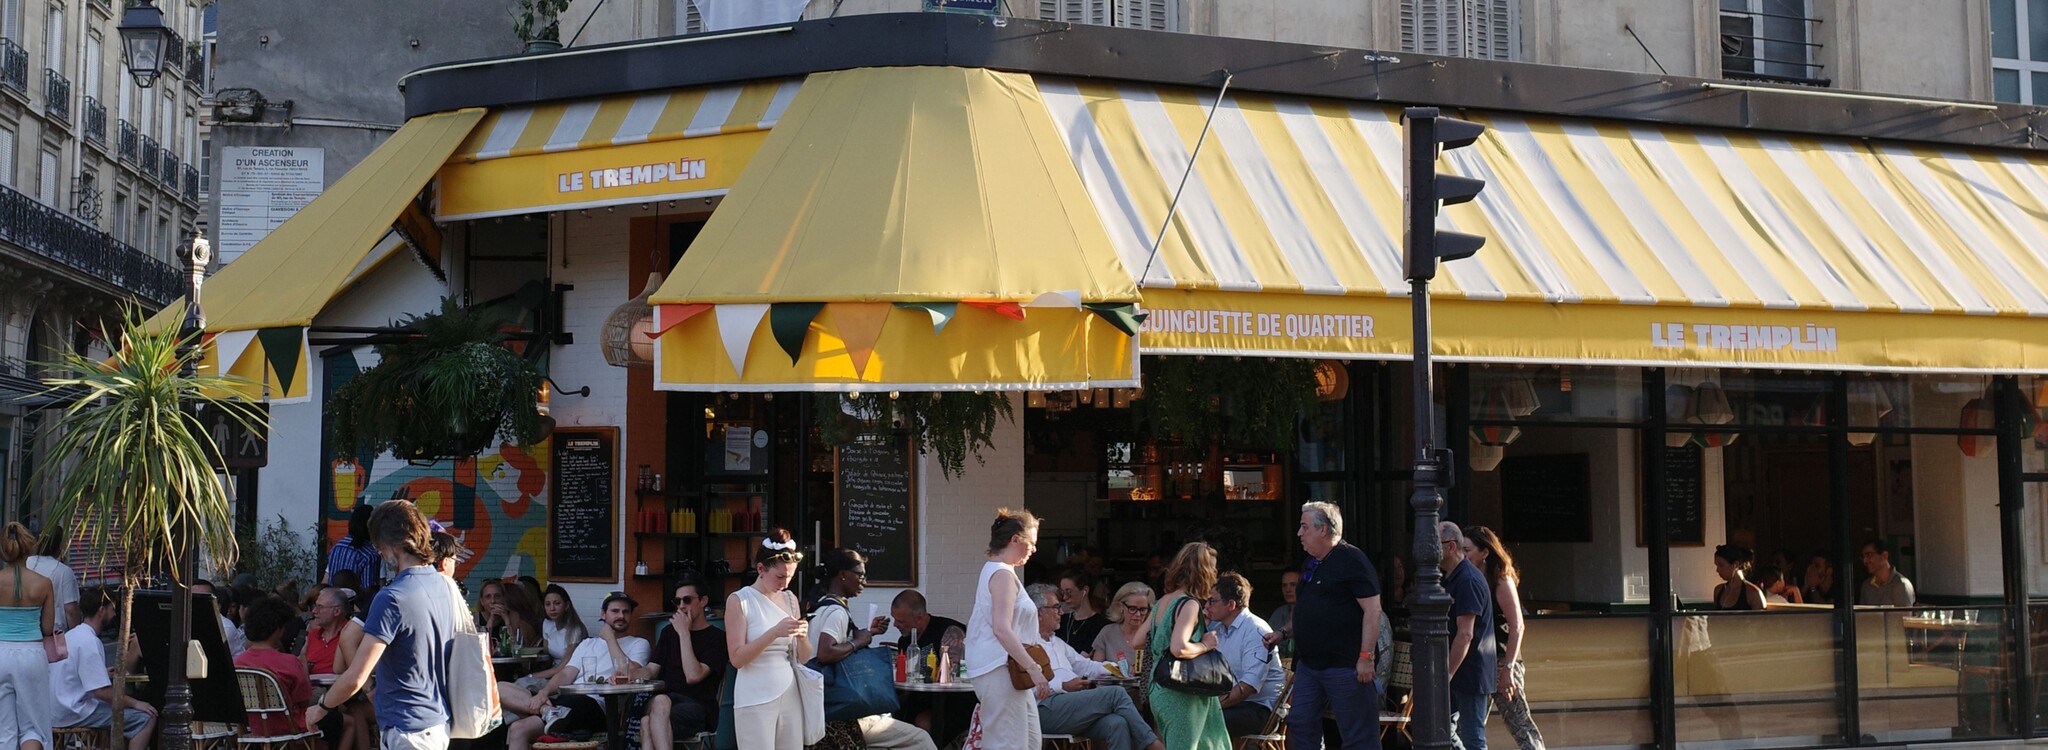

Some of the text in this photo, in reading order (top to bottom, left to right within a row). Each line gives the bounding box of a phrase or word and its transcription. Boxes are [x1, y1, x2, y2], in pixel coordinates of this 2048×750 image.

[558, 158, 706, 192] LE TREMPLIN
[1140, 308, 1375, 340] GUINGUETTE DE QUARTIER
[1651, 322, 1837, 352] LE TREMPLIN
